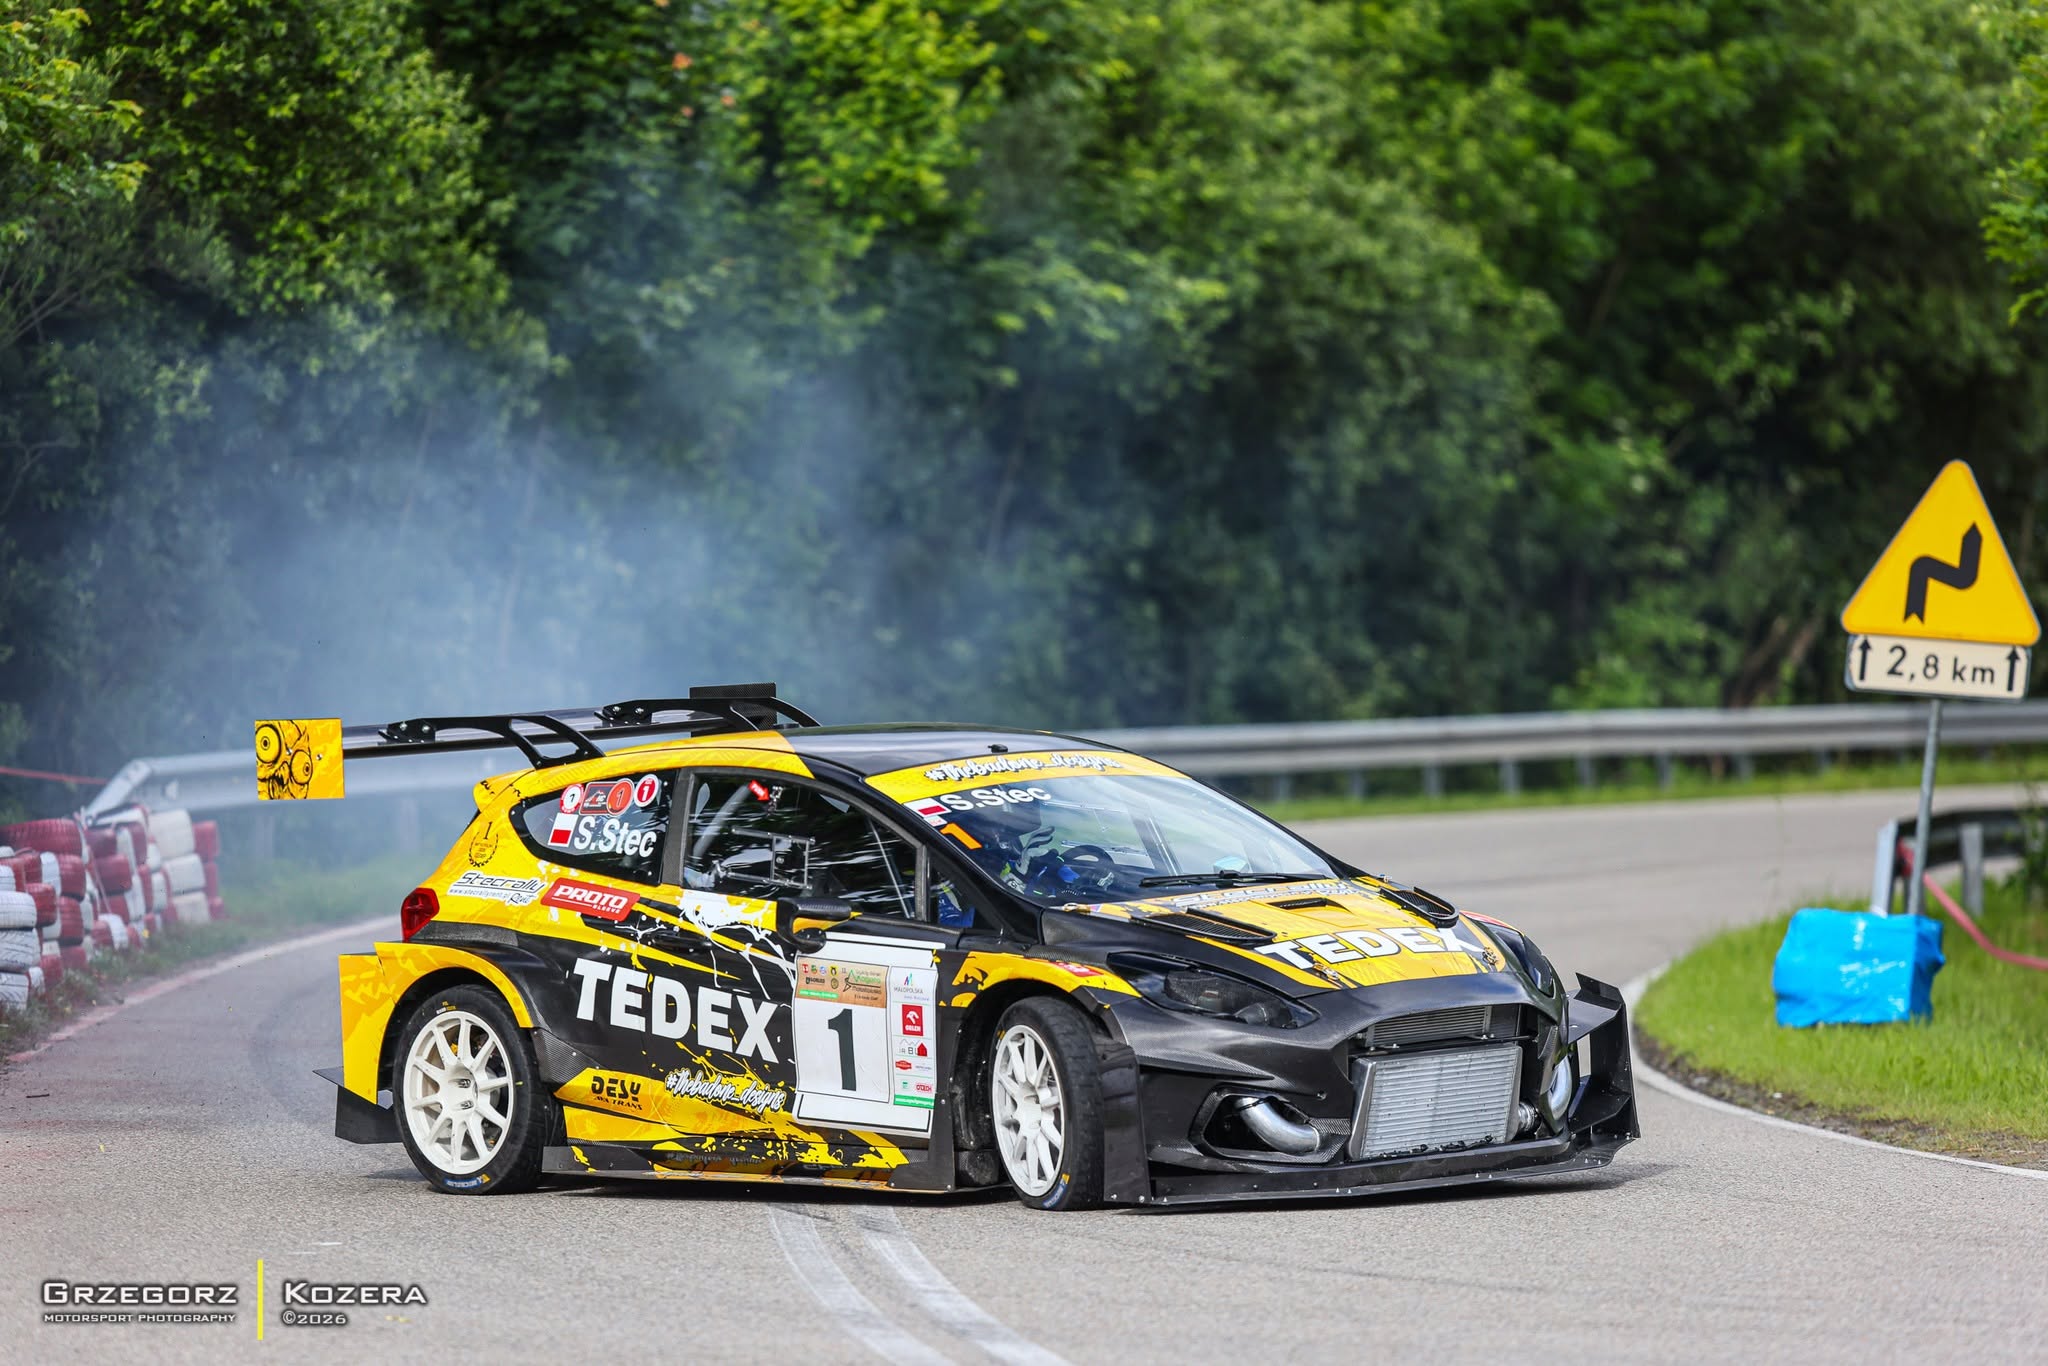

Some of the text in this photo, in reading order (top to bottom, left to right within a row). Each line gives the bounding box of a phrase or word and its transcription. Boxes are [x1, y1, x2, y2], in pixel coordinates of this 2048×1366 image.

[1886, 645, 1995, 684] 2,8 km
[940, 786, 1051, 812] S.Stec
[574, 815, 657, 858] S.Stec
[940, 822, 983, 850] 1
[553, 884, 629, 909] PROTO
[1254, 927, 1486, 970] TEDEX
[573, 958, 780, 1064] TEDEX
[827, 1008, 857, 1092] 1
